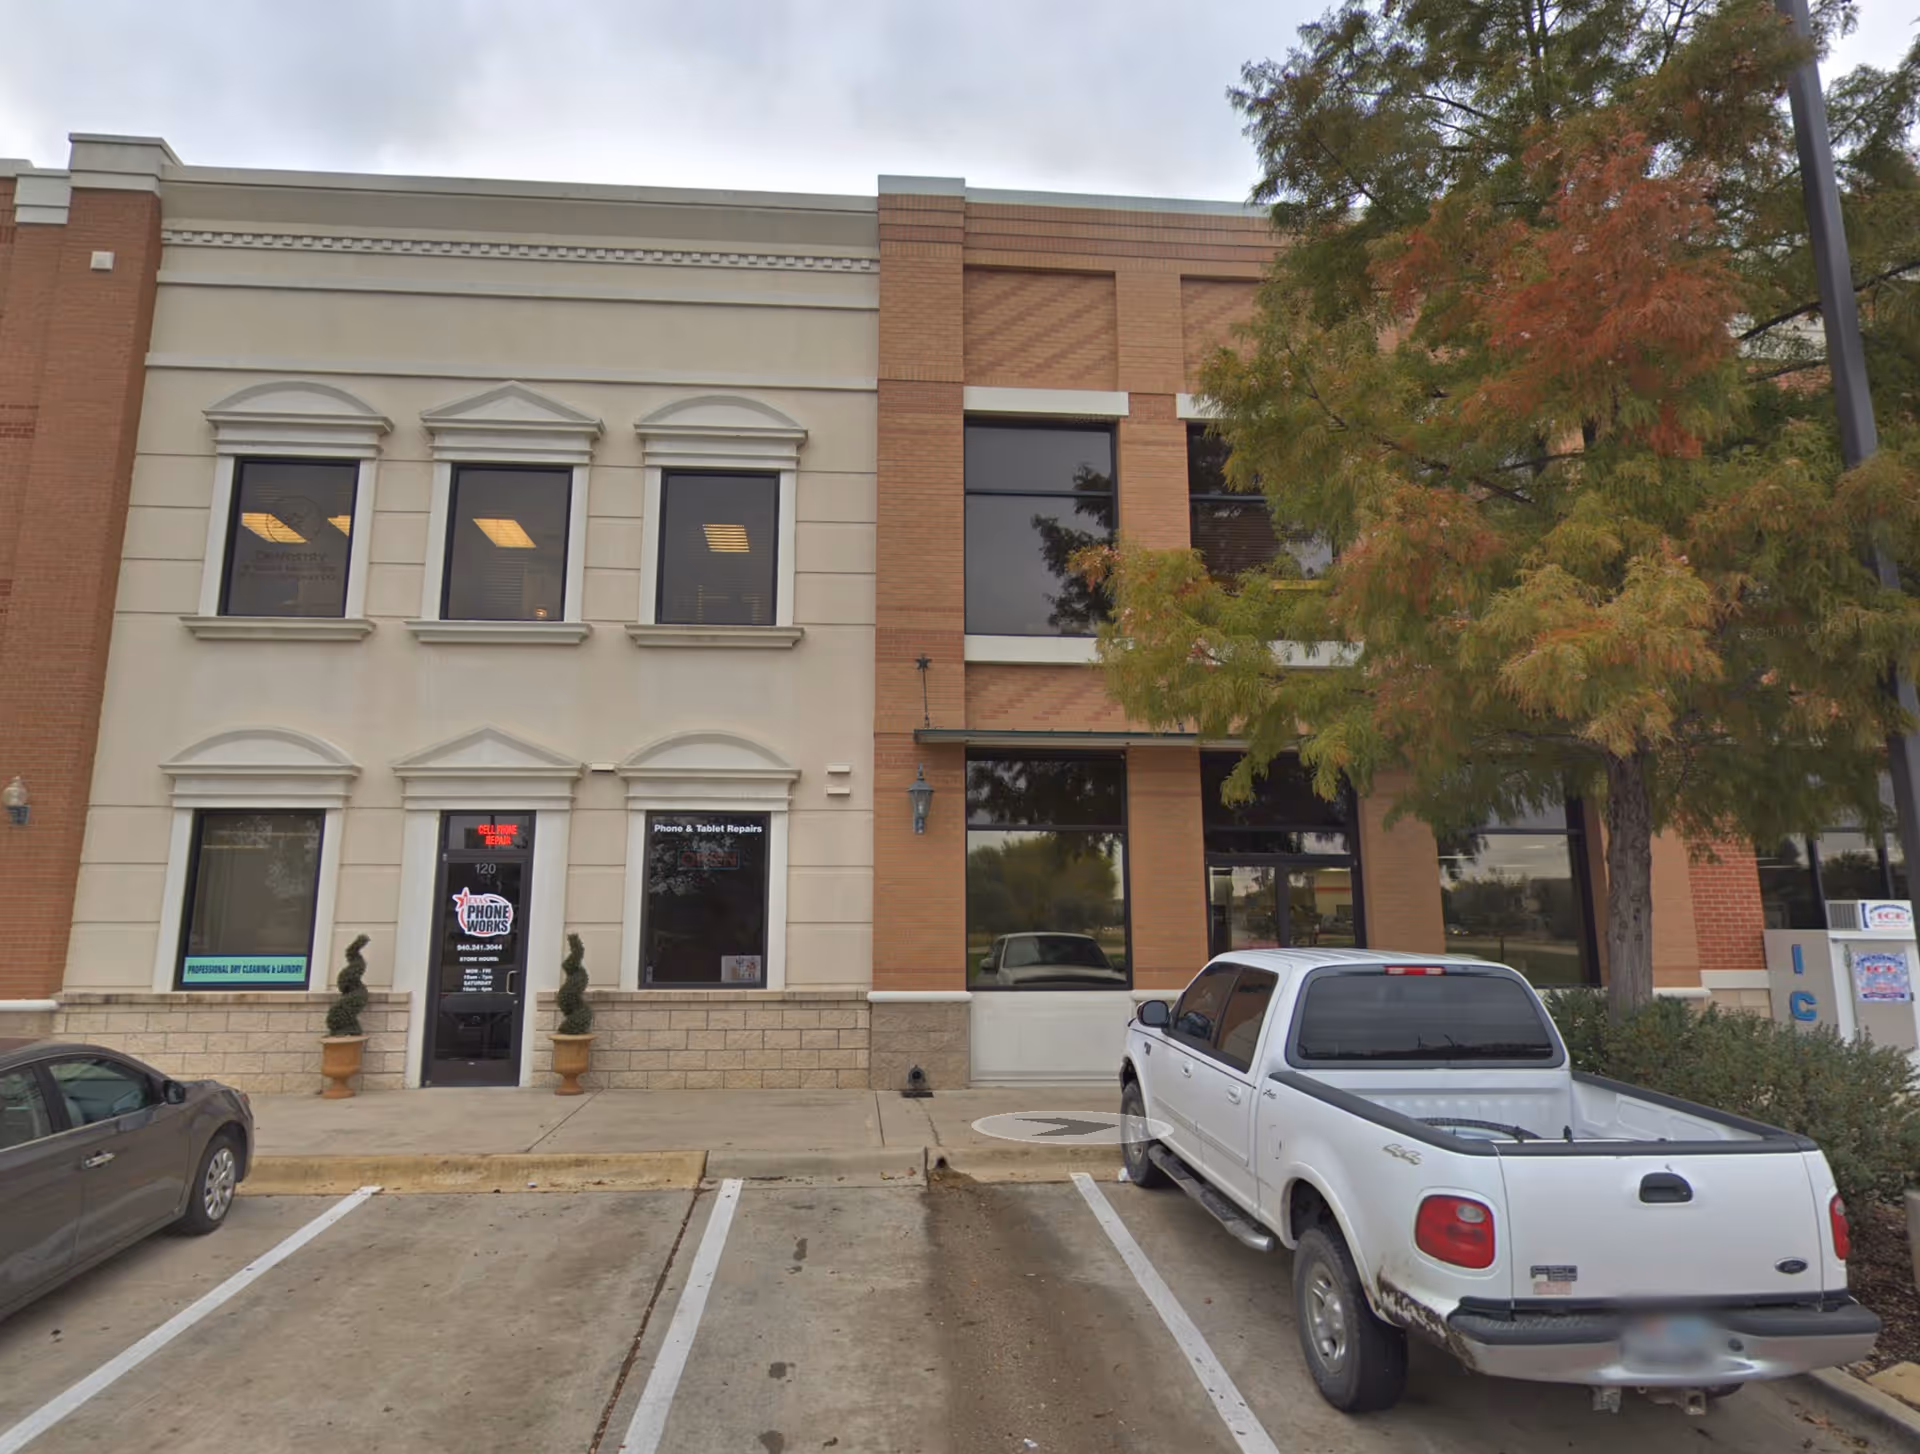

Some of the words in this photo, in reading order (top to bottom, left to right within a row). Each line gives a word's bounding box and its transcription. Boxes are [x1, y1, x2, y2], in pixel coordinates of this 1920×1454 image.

[478, 824, 496, 834] CELL
[496, 824, 517, 834] PHONE
[654, 824, 684, 833] Phone
[686, 824, 694, 833] &
[696, 824, 724, 833] Tablet
[727, 824, 762, 834] Repairs
[485, 835, 511, 845] REPAIR
[475, 863, 496, 874] 120
[467, 904, 509, 919] PHONE
[466, 920, 508, 932] WORKS
[187, 964, 228, 974] PROFESSIONAL
[230, 964, 241, 974] DRY
[242, 964, 270, 974] CLEANING
[277, 964, 303, 974] LAUNDRY
